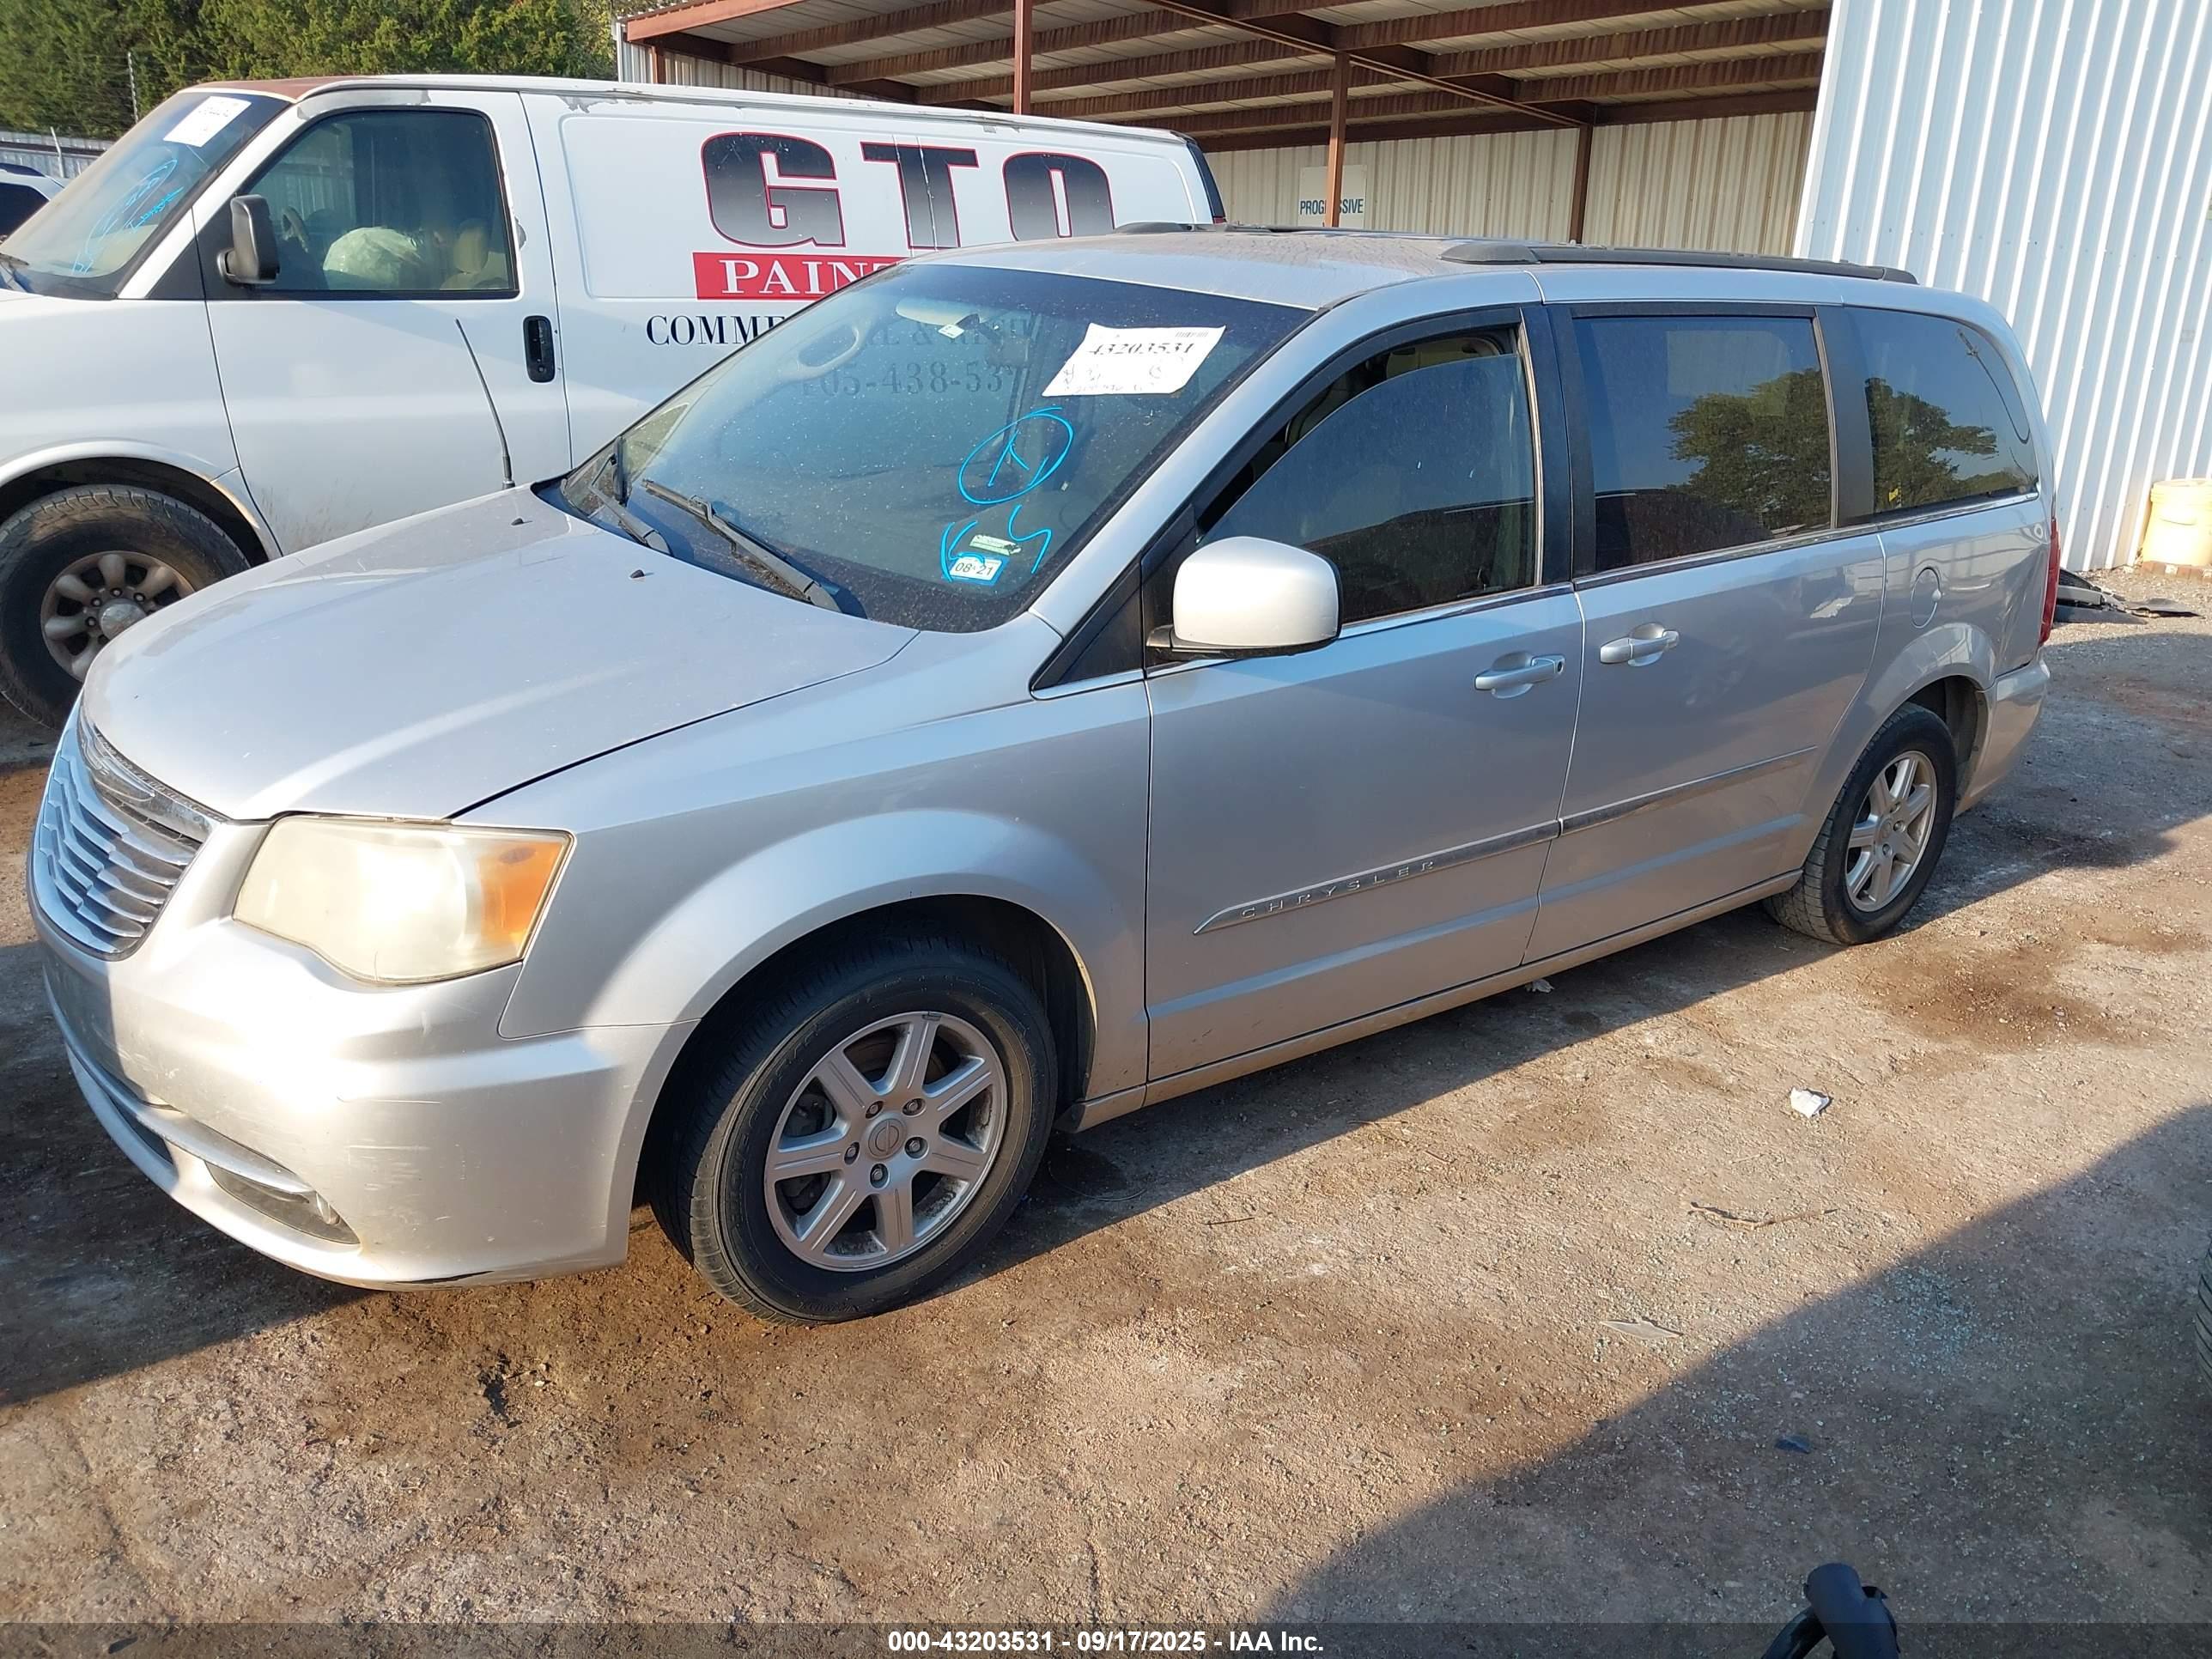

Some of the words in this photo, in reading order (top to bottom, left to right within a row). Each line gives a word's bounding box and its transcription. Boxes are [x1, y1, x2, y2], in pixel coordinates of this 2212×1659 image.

[700, 131, 1115, 251] GTO
[1299, 198, 1364, 215] PROGSIVE
[719, 259, 899, 295] PAIN
[1088, 343, 1195, 356] 43203531
[1241, 860, 1434, 919] CHRYSLER
